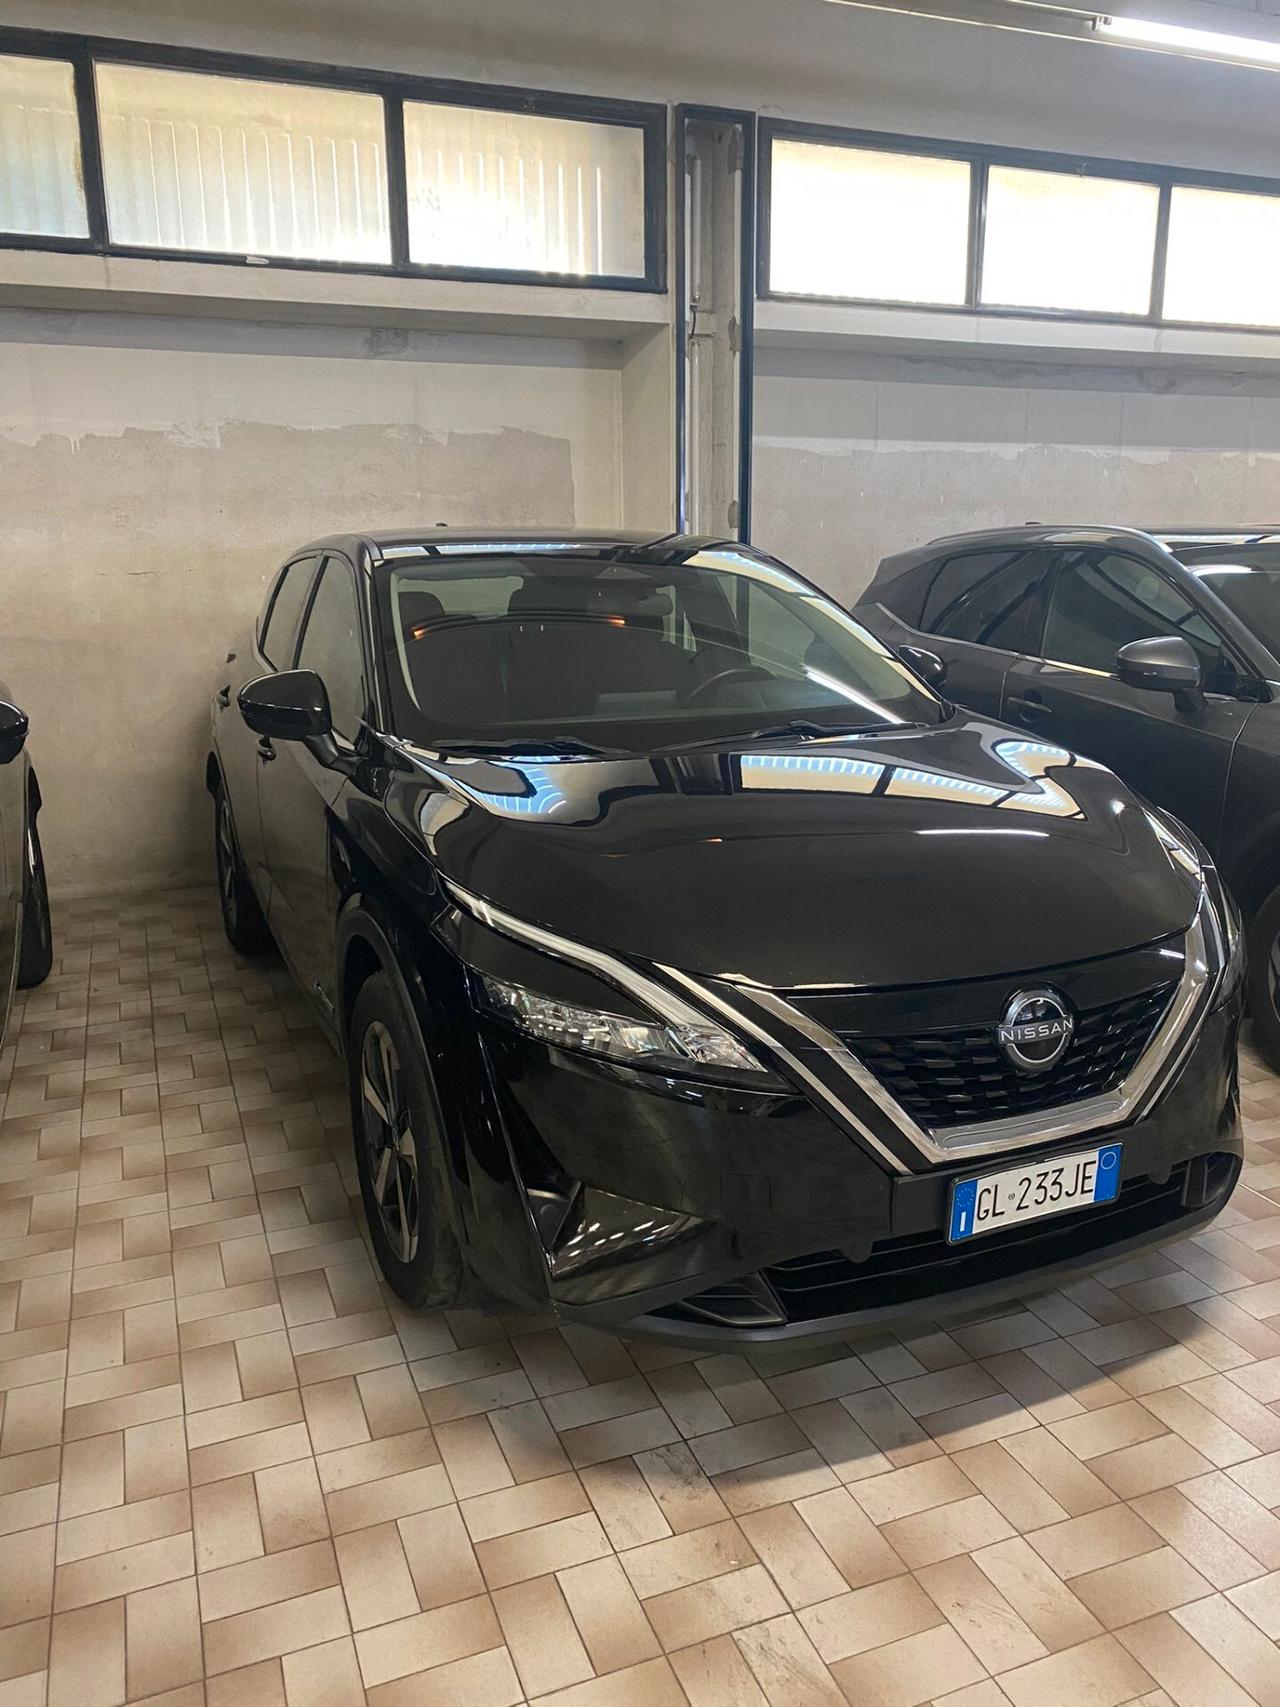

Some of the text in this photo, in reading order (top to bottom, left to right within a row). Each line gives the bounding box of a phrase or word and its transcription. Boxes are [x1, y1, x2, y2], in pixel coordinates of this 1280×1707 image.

[1001, 1017, 1073, 1042] NISSAN
[959, 1160, 1097, 1232] I GL 233JE
